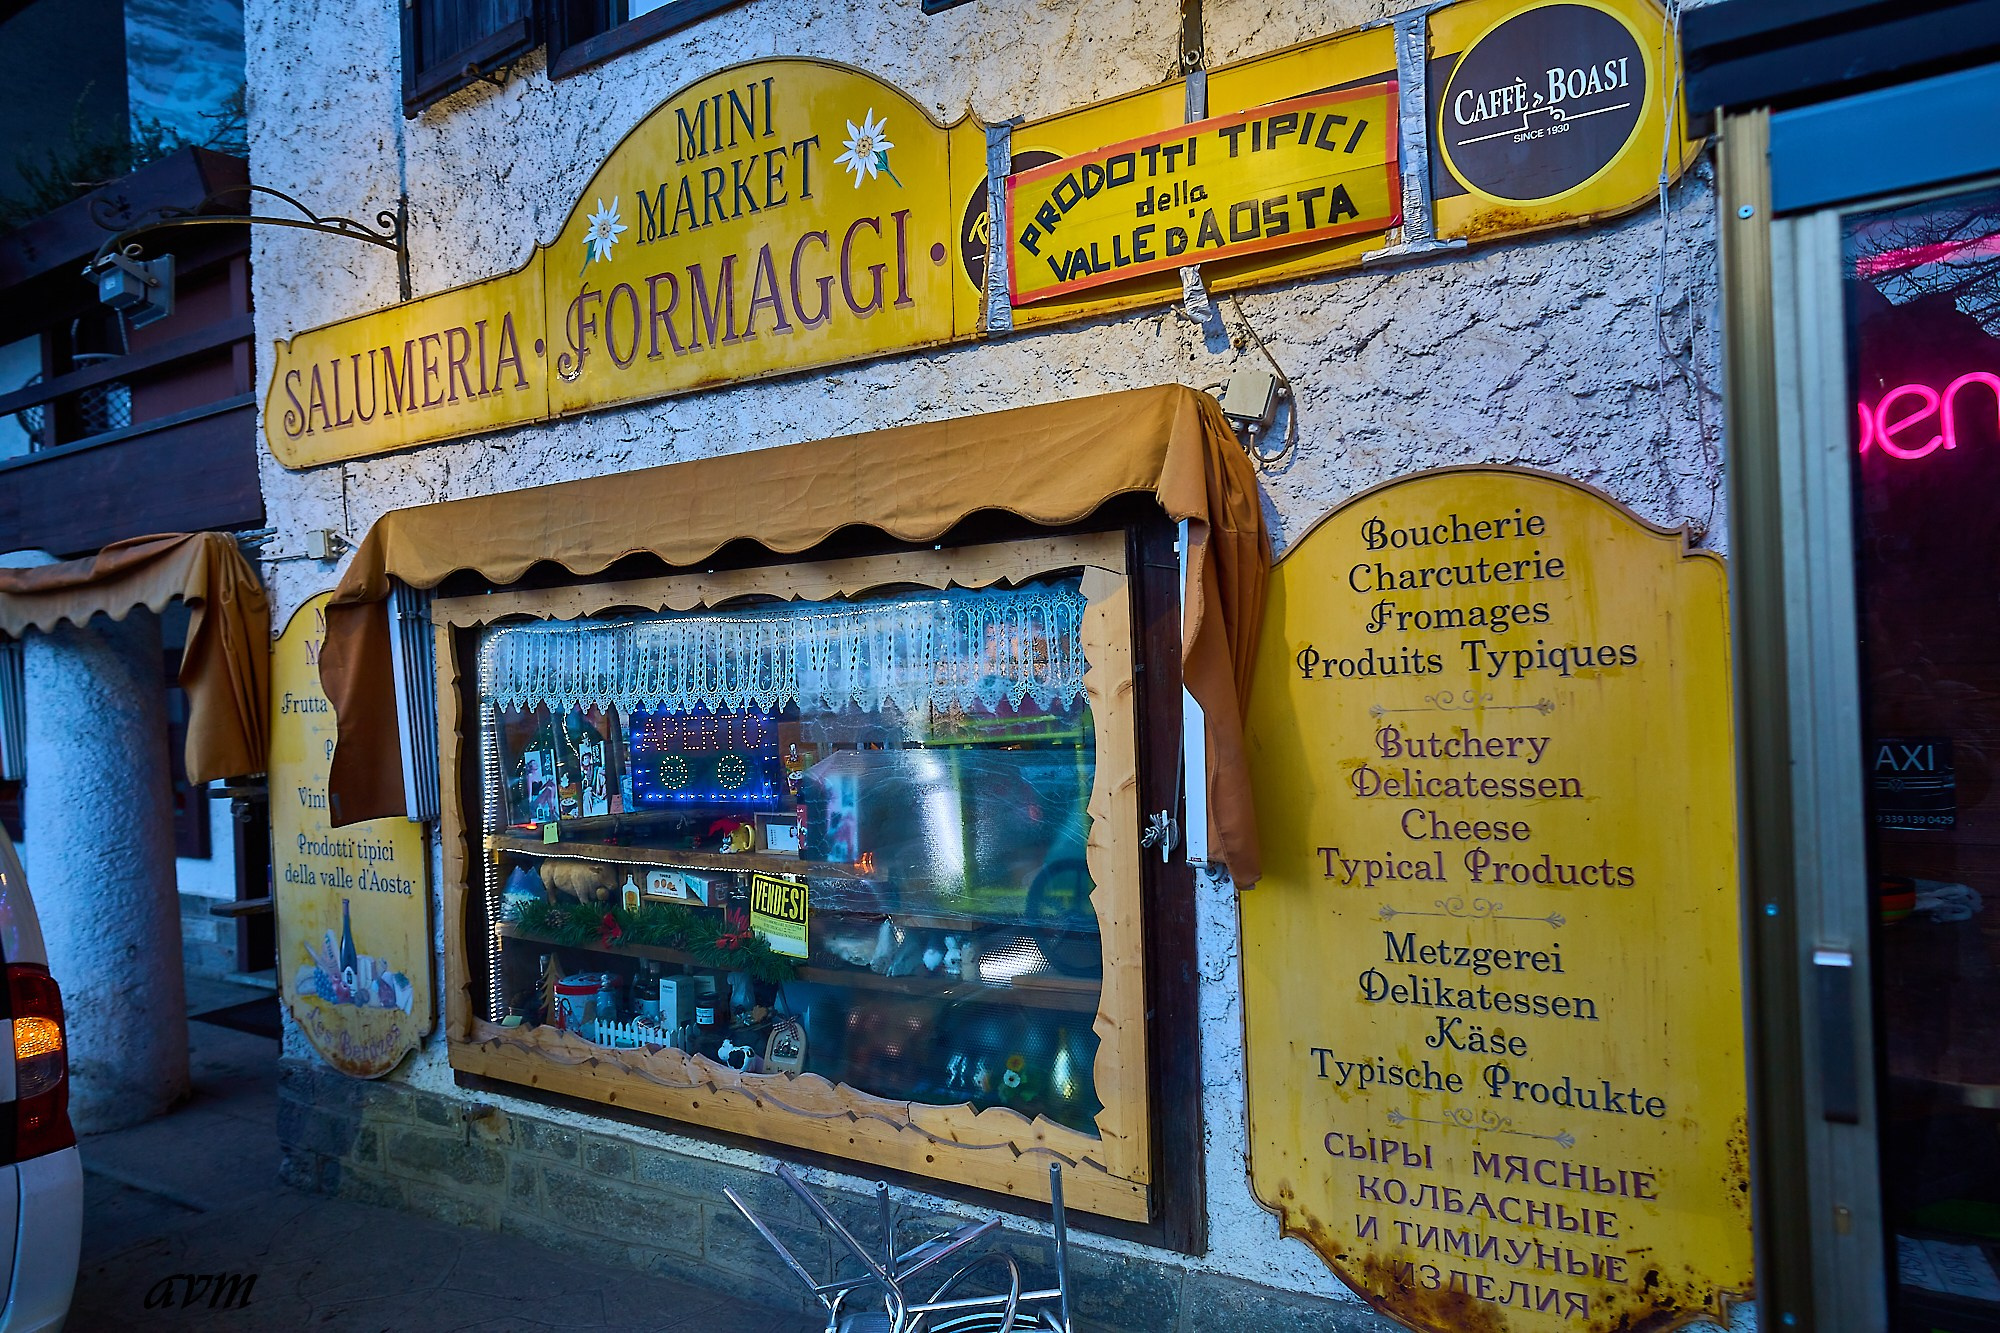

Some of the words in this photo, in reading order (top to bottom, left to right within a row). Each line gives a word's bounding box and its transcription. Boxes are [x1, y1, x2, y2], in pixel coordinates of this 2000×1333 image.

[1454, 76, 1528, 126] CAFFÈ
[1546, 57, 1629, 105] BOASI
[674, 76, 775, 166] MINI
[1513, 129, 1545, 144] SINCE
[1546, 123, 1570, 137] 1930
[636, 134, 820, 246] MARKET
[1019, 137, 1197, 257] PRODOTTI
[1219, 112, 1369, 158] TIPICI
[1136, 179, 1208, 217] della
[1046, 223, 1156, 282] VALLE
[284, 311, 530, 440] SALUMERIA
[557, 208, 915, 383] FORMAGGI
[1361, 508, 1546, 552] Boucherie
[1348, 550, 1566, 594] Charcuterie
[1365, 598, 1551, 634] Fromages
[1296, 644, 1443, 679] Produits
[1460, 639, 1638, 679] Typiques
[281, 693, 328, 714] Frutta
[641, 714, 763, 752] APERTO
[1375, 724, 1551, 764] Butchery
[1874, 745, 1935, 771] AXI
[298, 786, 326, 808] Vini
[1351, 762, 1584, 799] Delicatessen
[1400, 808, 1531, 842] Cheese
[297, 833, 353, 858] Prodotti
[357, 839, 394, 866] tipici
[1316, 846, 1447, 887] Typical
[1463, 846, 1636, 888] Products
[285, 863, 316, 886] della
[319, 866, 353, 891] valle
[358, 869, 412, 896] d'Aosta
[755, 880, 805, 921] VENDESI
[1383, 930, 1566, 975] Metzgerei
[1358, 966, 1599, 1021] Delikatessen
[1425, 1016, 1528, 1058] Käse
[1310, 1047, 1464, 1093] Typische
[1482, 1063, 1667, 1119] Produkte
[1323, 1131, 1433, 1170] СЫРЫ
[1472, 1150, 1659, 1202] МЯСНЫЕ
[1354, 1213, 1380, 1241] И
[1357, 1174, 1620, 1239] КОЛБАСНЫЕ
